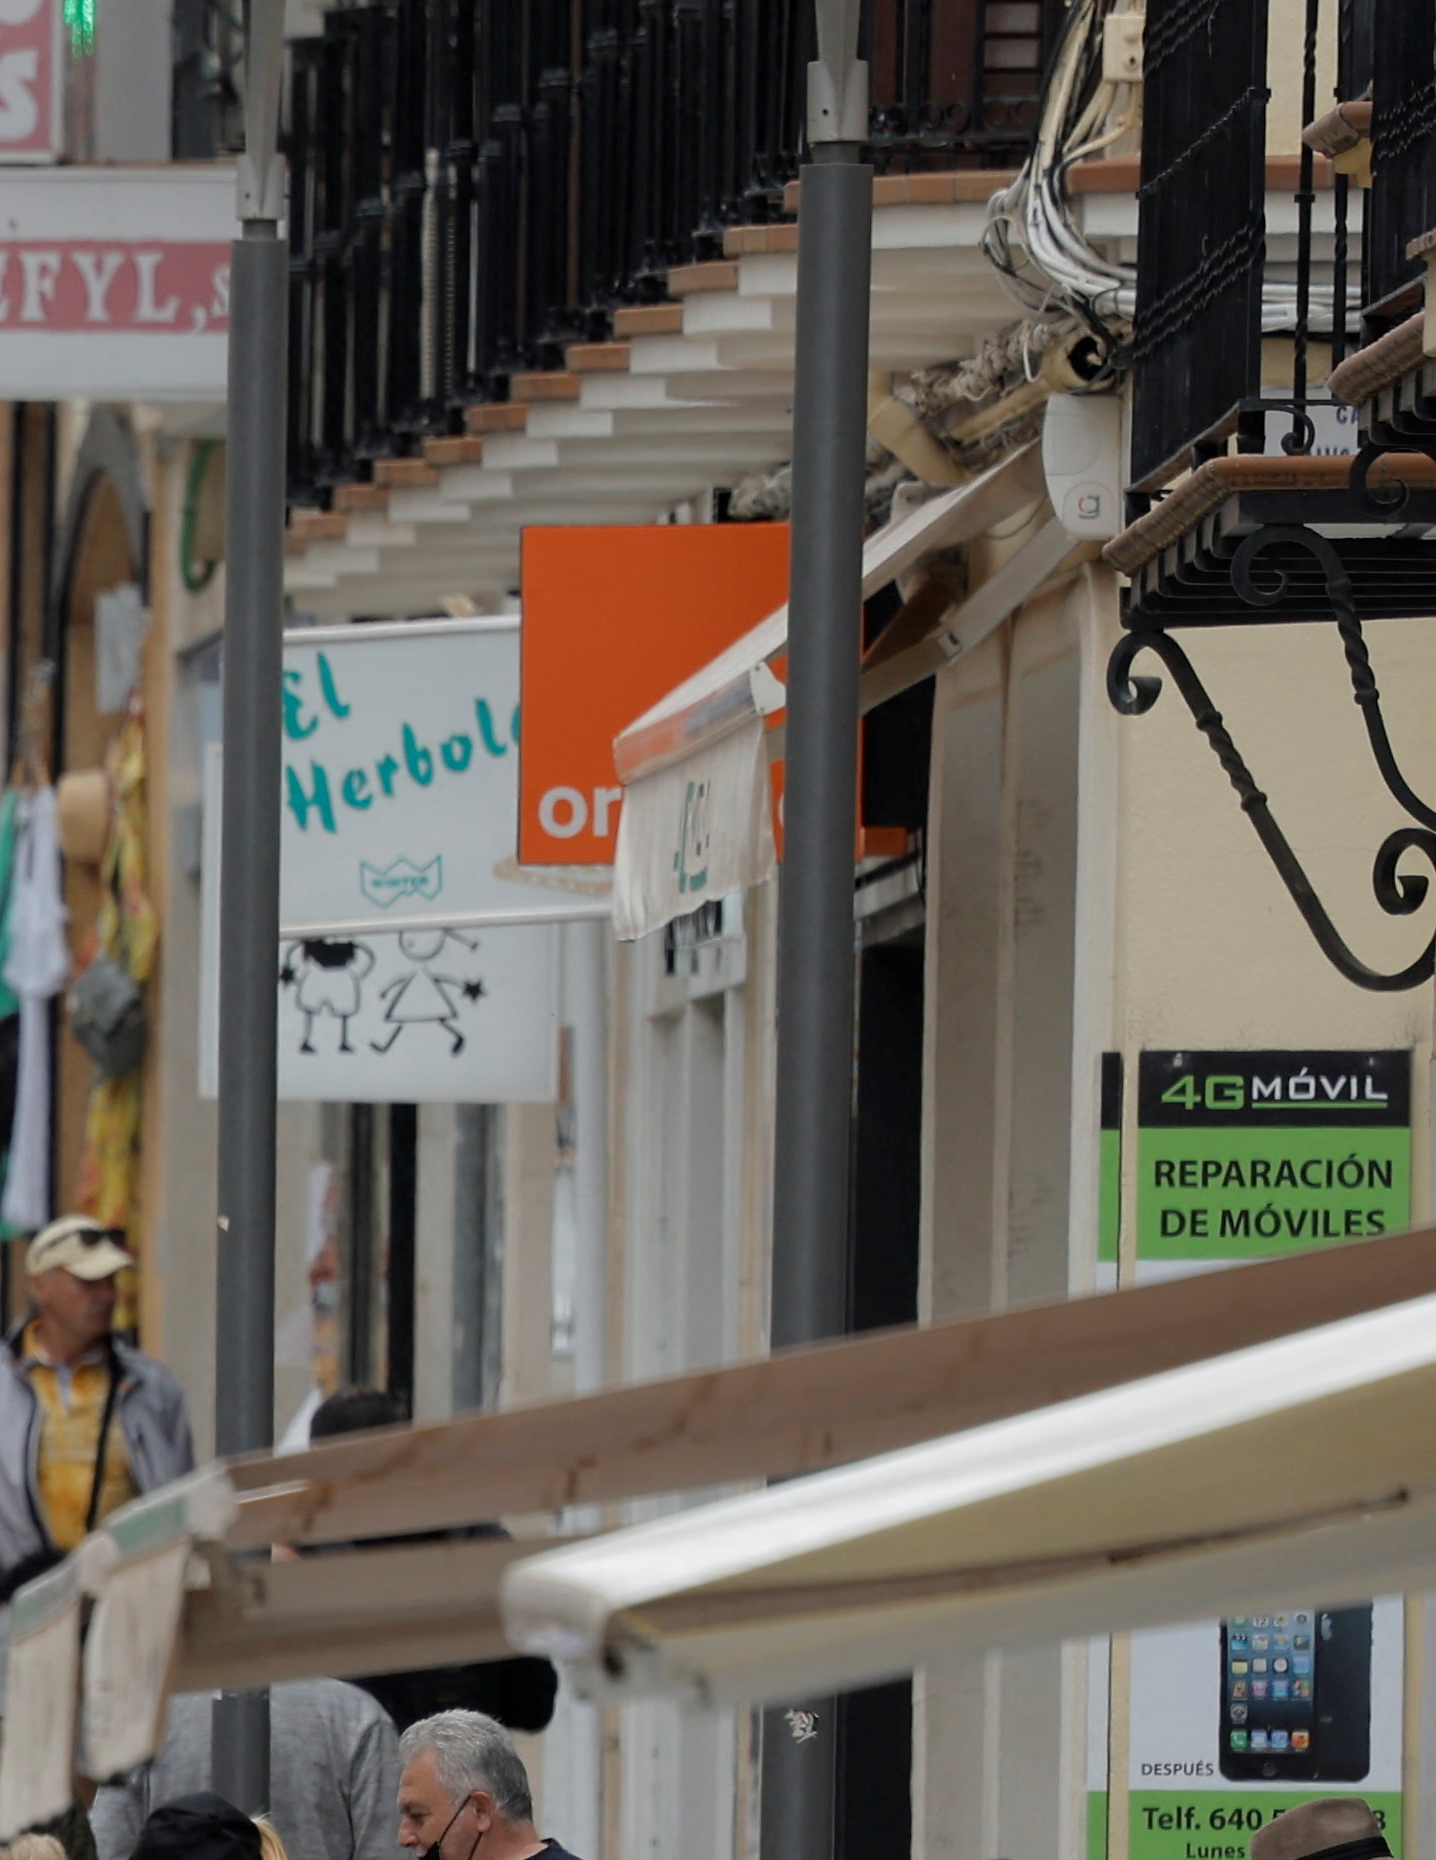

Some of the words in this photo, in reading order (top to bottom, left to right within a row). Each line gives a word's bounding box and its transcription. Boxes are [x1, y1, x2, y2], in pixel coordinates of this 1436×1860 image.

[285, 697, 521, 834] Herbol
[1252, 1066, 1388, 1101] MÓVIL
[1154, 1152, 1393, 1189] REPARACIÓN
[1159, 1209, 1209, 1238] DE
[1219, 1202, 1386, 1238] MÓVILES
[1141, 1759, 1215, 1777] DESPUÉS
[1142, 1806, 1201, 1831] Telf.
[1209, 1808, 1263, 1831] 640
[1185, 1842, 1246, 1860] Lunes
